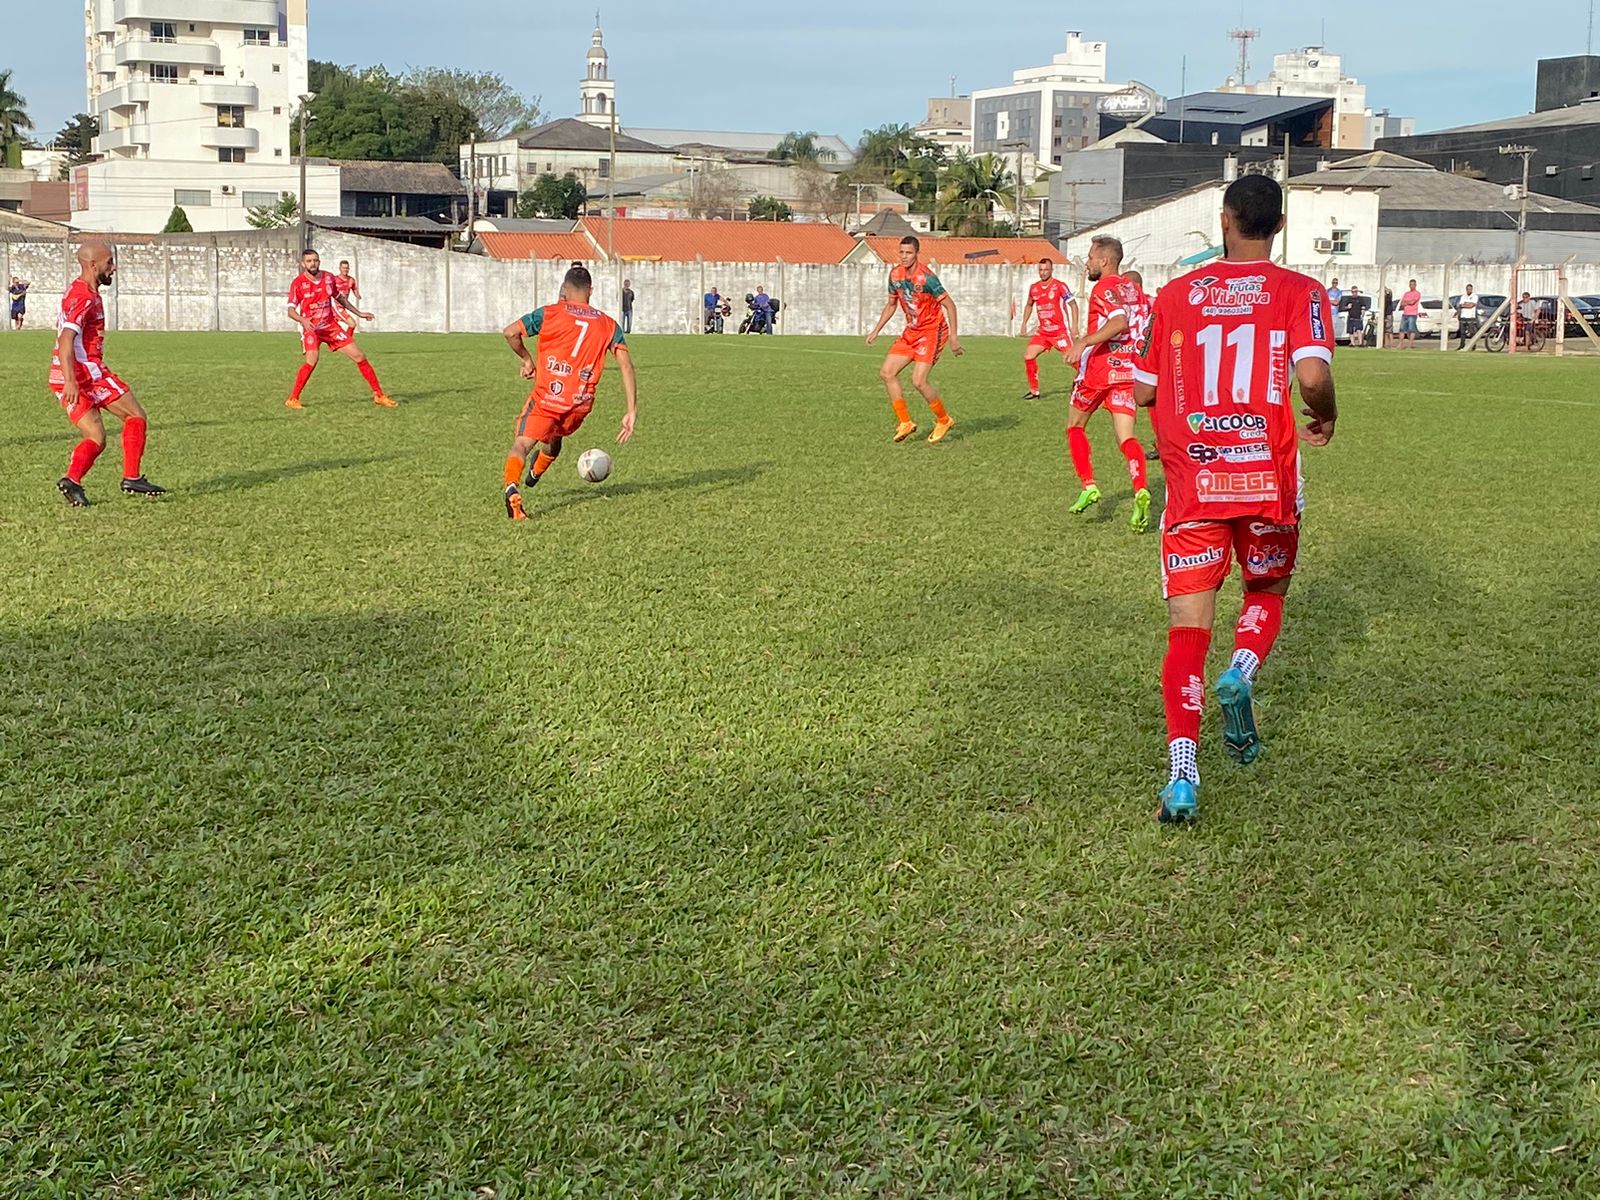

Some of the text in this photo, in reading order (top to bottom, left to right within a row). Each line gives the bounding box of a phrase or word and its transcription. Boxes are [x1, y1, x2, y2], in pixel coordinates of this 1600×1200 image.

[1229, 283, 1261, 293] frutas
[571, 320, 589, 357] 7
[1174, 348, 1183, 375] POSTO
[1196, 323, 1256, 407] 11
[1204, 414, 1266, 431] SICOOB
[1234, 443, 1271, 454] DIESE
